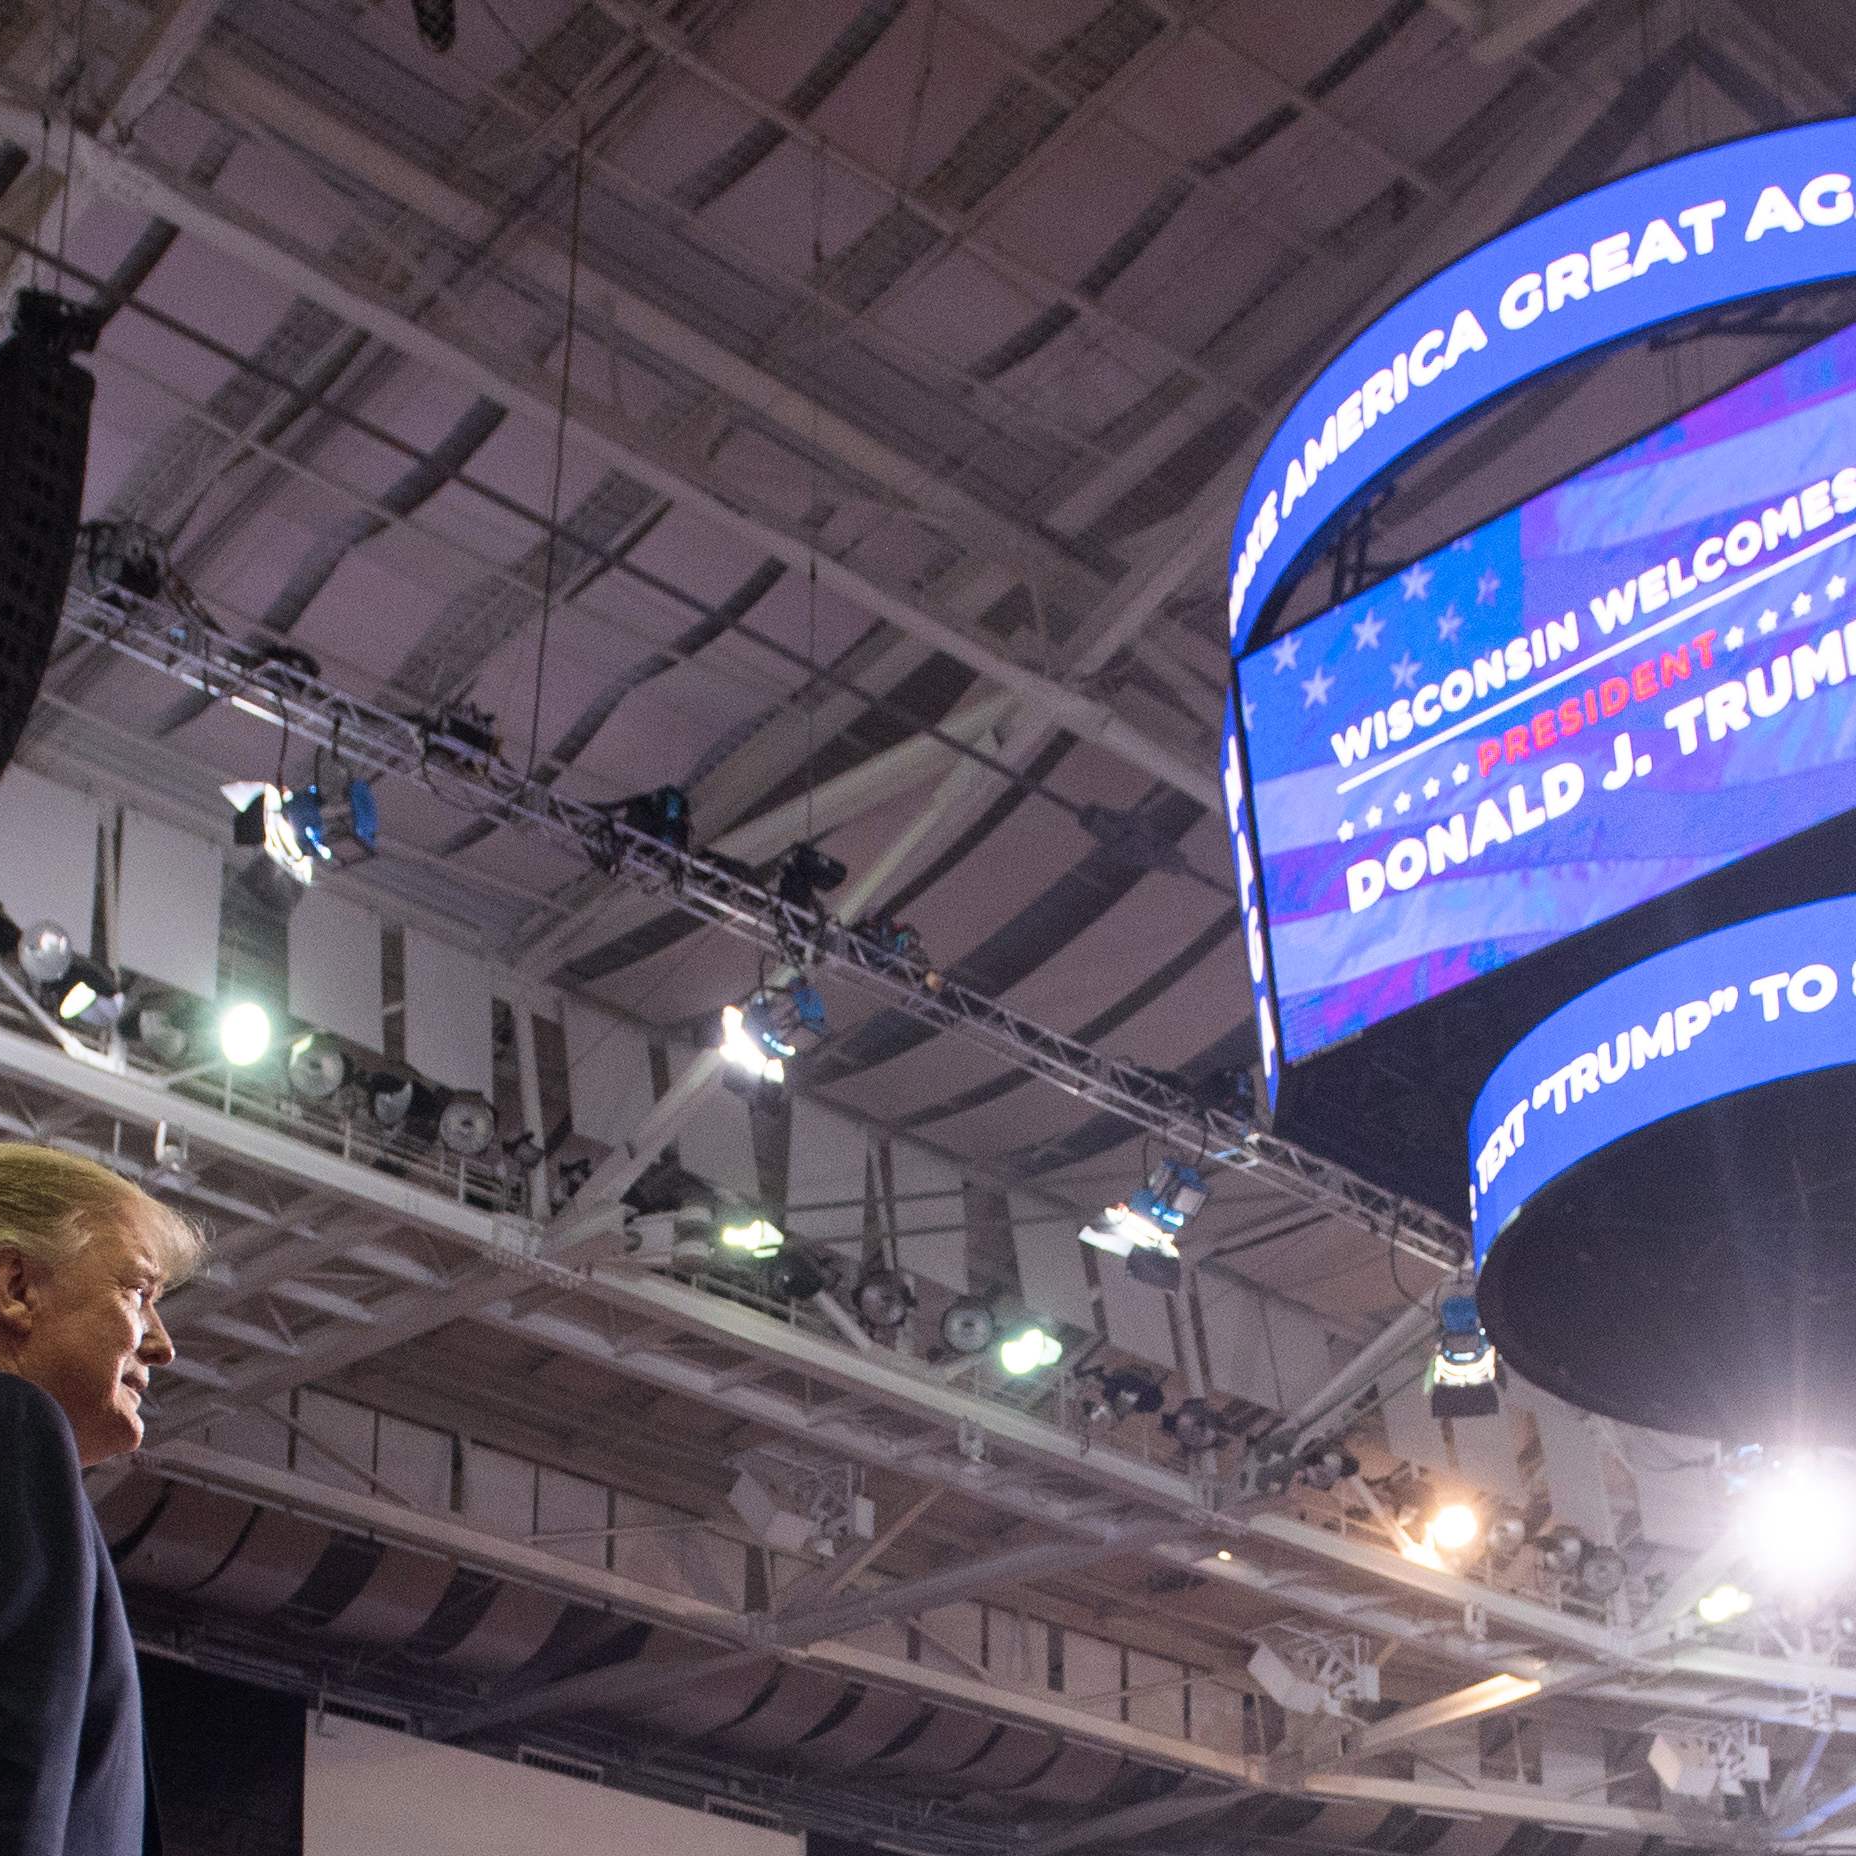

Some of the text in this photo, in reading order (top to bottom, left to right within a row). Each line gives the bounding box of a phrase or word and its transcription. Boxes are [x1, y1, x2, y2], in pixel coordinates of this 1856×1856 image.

[1281, 309, 1488, 519] AMERICA
[1499, 201, 1726, 330] GREAT
[1331, 611, 1580, 768] WISCONSIN
[1477, 629, 1718, 778] PRESIDENT
[1346, 761, 1585, 914] DONALD
[1602, 733, 1653, 791] J.
[1476, 1099, 1529, 1195] TEXT
[1749, 963, 1838, 1022] TO
